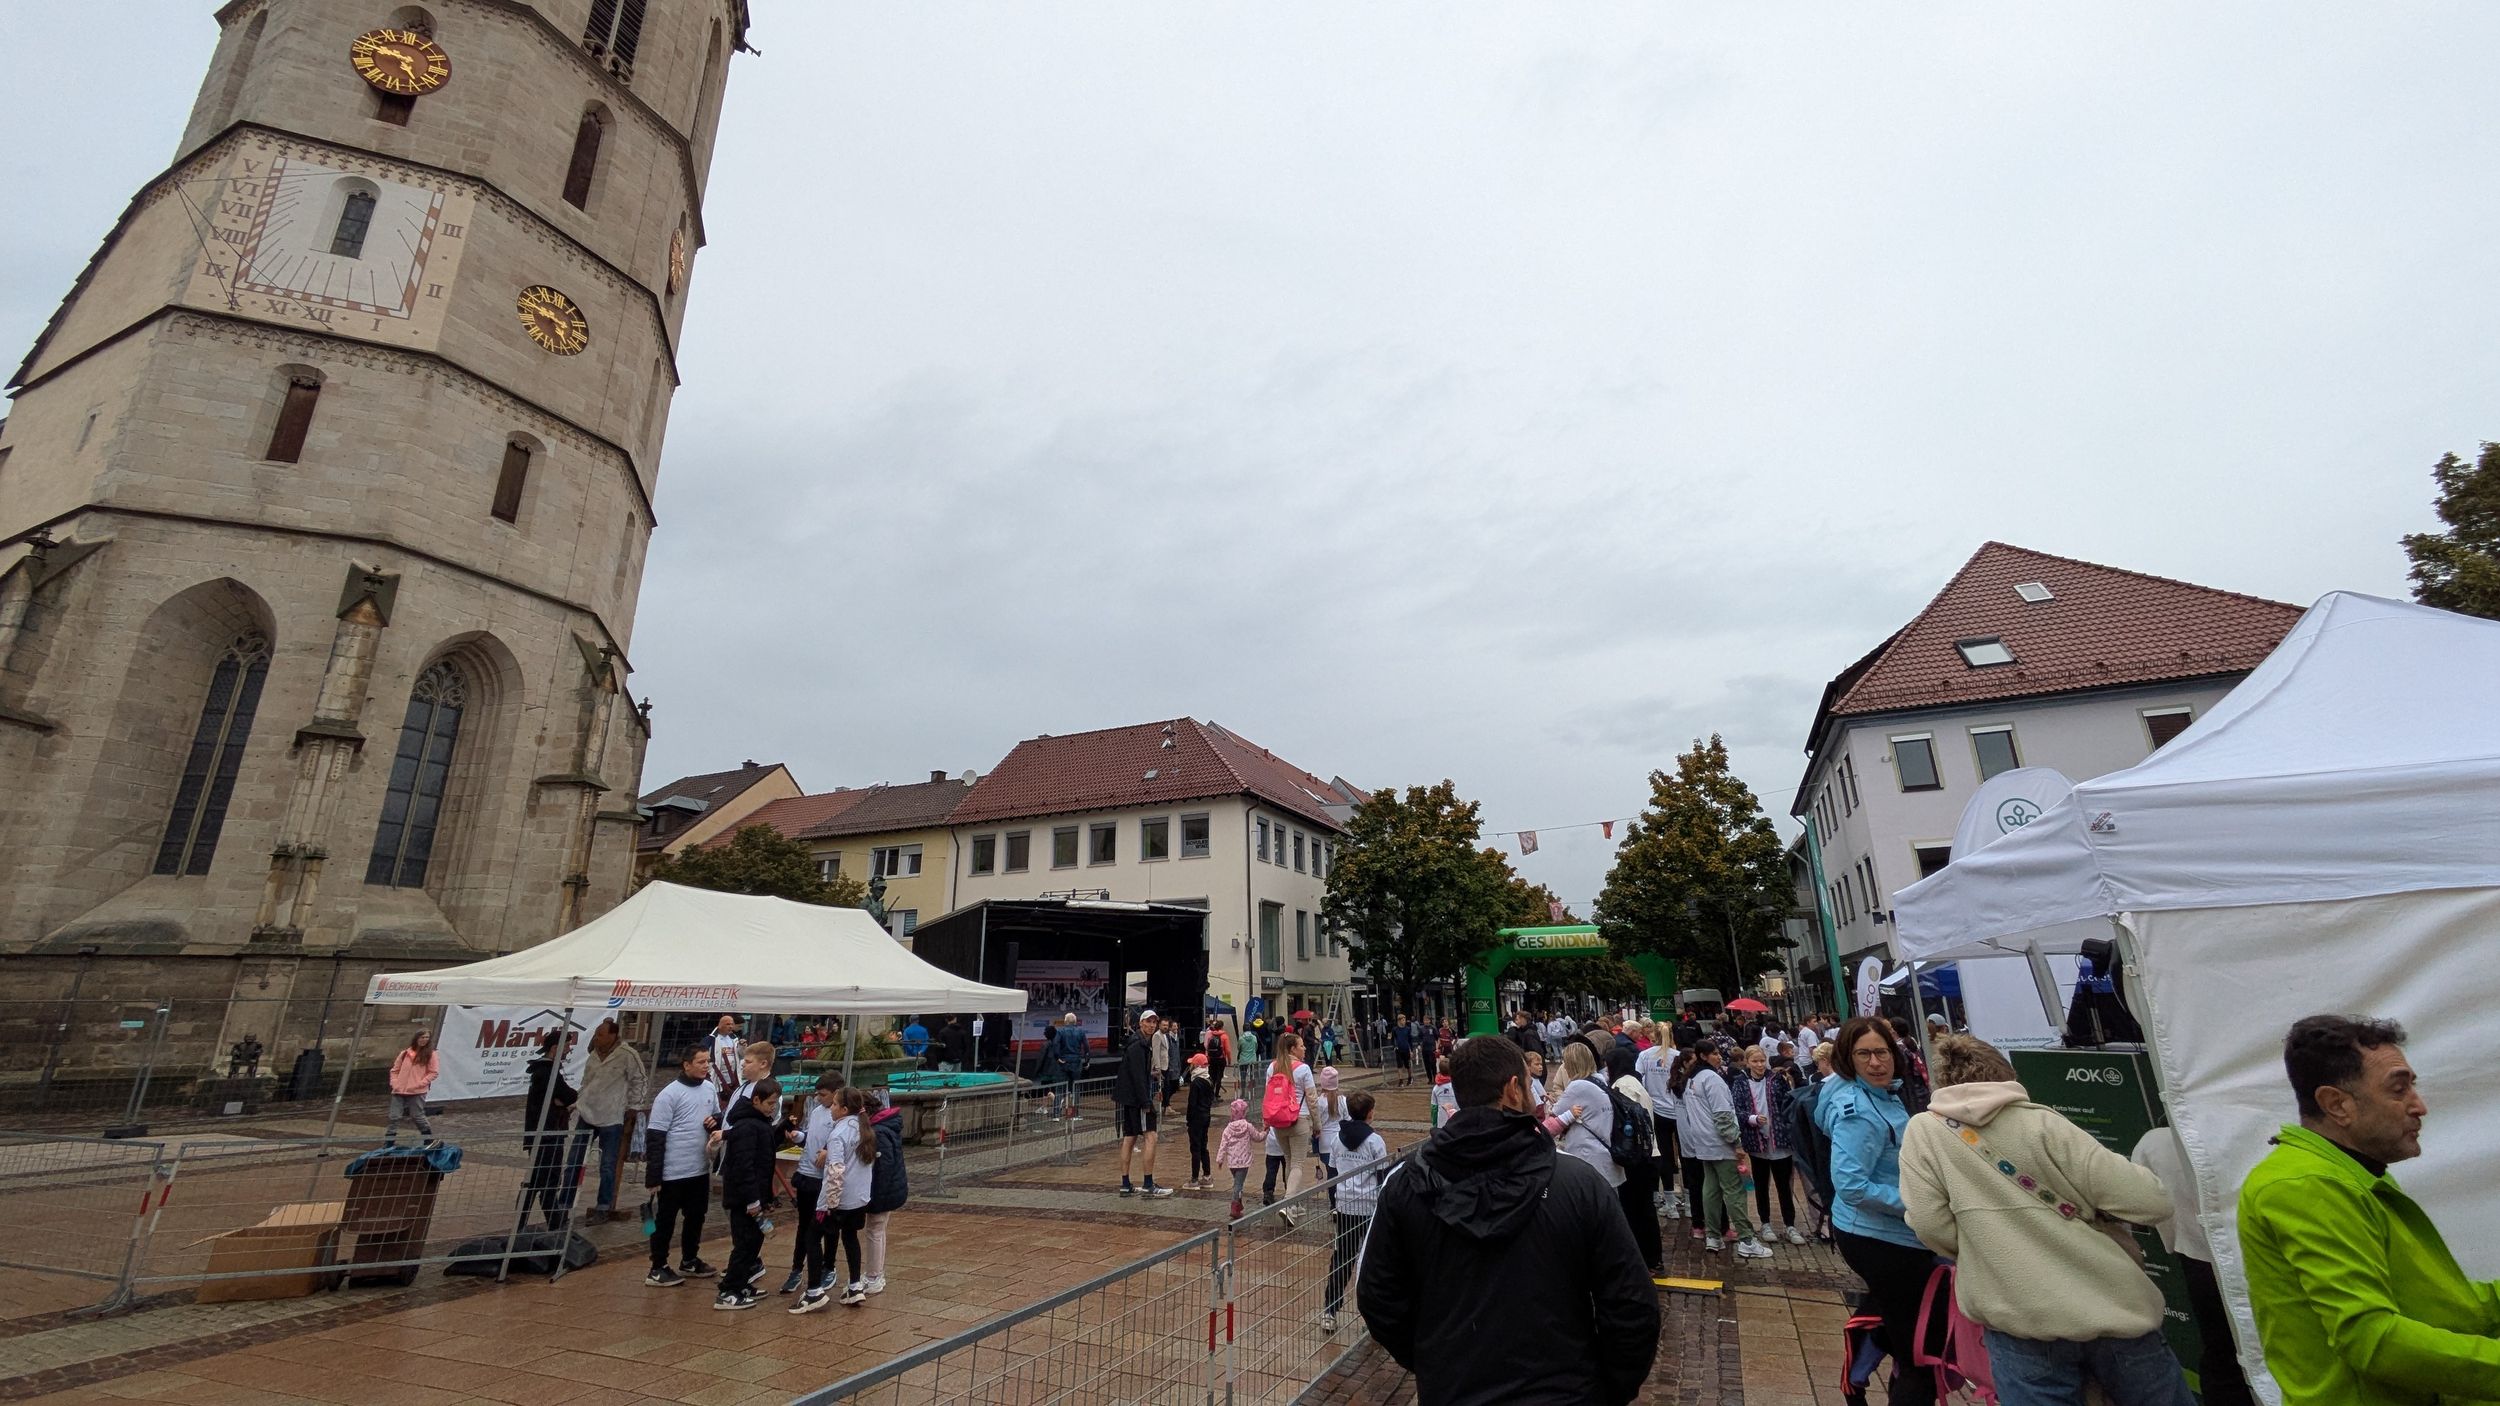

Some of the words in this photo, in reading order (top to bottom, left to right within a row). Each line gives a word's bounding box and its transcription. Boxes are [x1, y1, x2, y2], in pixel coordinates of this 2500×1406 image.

[400, 31, 416, 46] XII
[243, 158, 263, 173] V
[231, 179, 261, 198] VI
[220, 199, 255, 219] VII
[210, 226, 249, 245] VIII
[440, 223, 464, 239] III
[201, 261, 231, 280] IX
[426, 283, 444, 299] II
[264, 298, 291, 316] XI
[300, 305, 335, 323] XII
[370, 318, 382, 332] I
[630, 985, 742, 1000] LEICHTATHLETIK
[1471, 1000, 1490, 1009] AOK
[482, 1067, 504, 1075] Umbau
[2065, 1068, 2103, 1083] AOK
